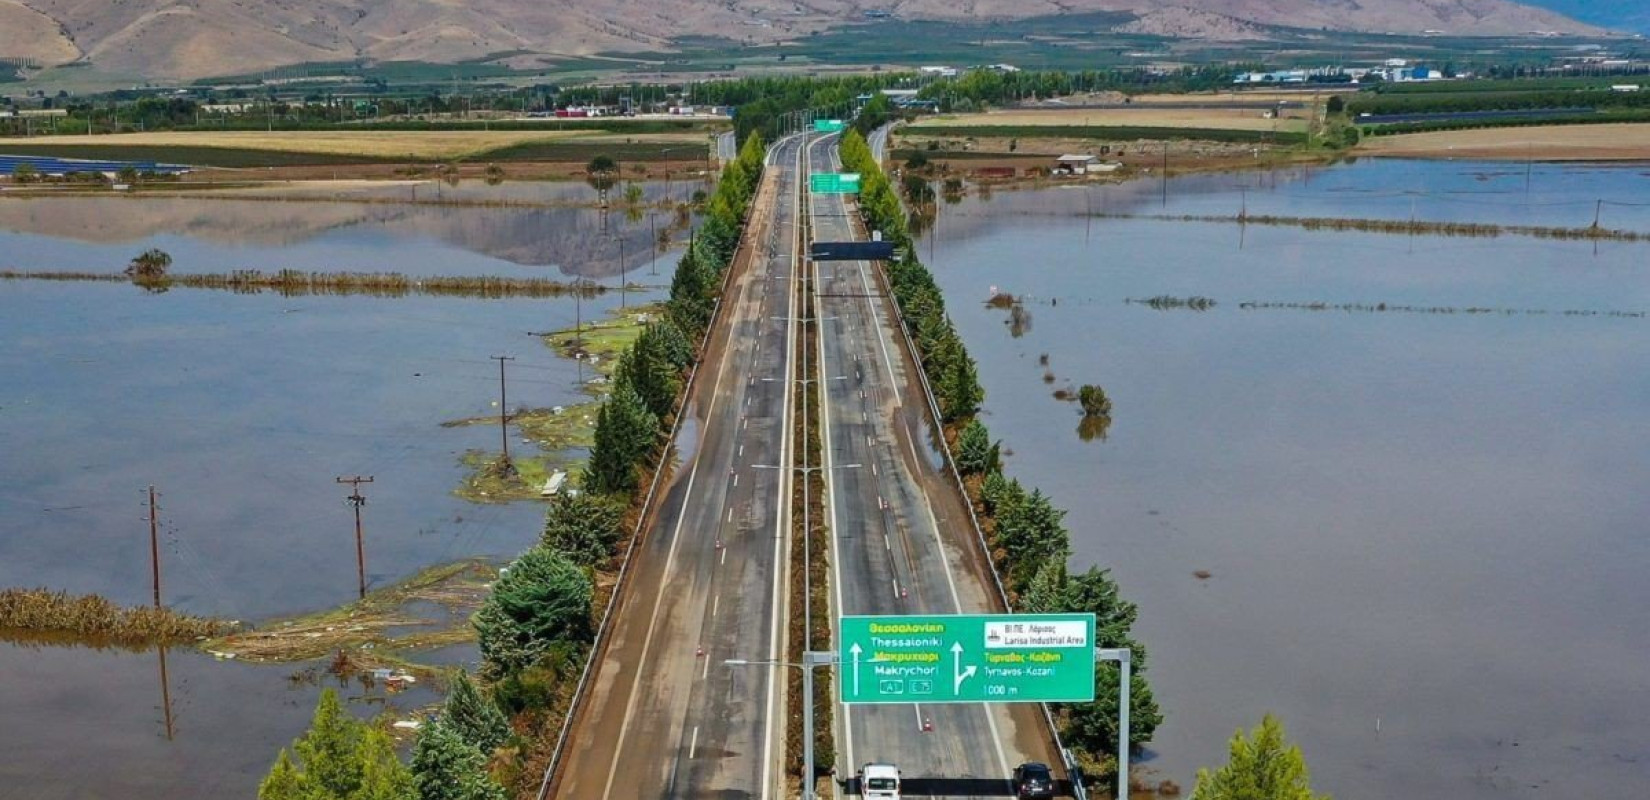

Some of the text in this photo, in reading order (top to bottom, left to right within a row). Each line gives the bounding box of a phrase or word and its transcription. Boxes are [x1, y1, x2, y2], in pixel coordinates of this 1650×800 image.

[870, 636, 942, 647] Thessaloniki
[1004, 636, 1084, 645] Larisa Industrial Area
[875, 665, 939, 678] Makrychori
[983, 684, 1018, 695] 1000 m
